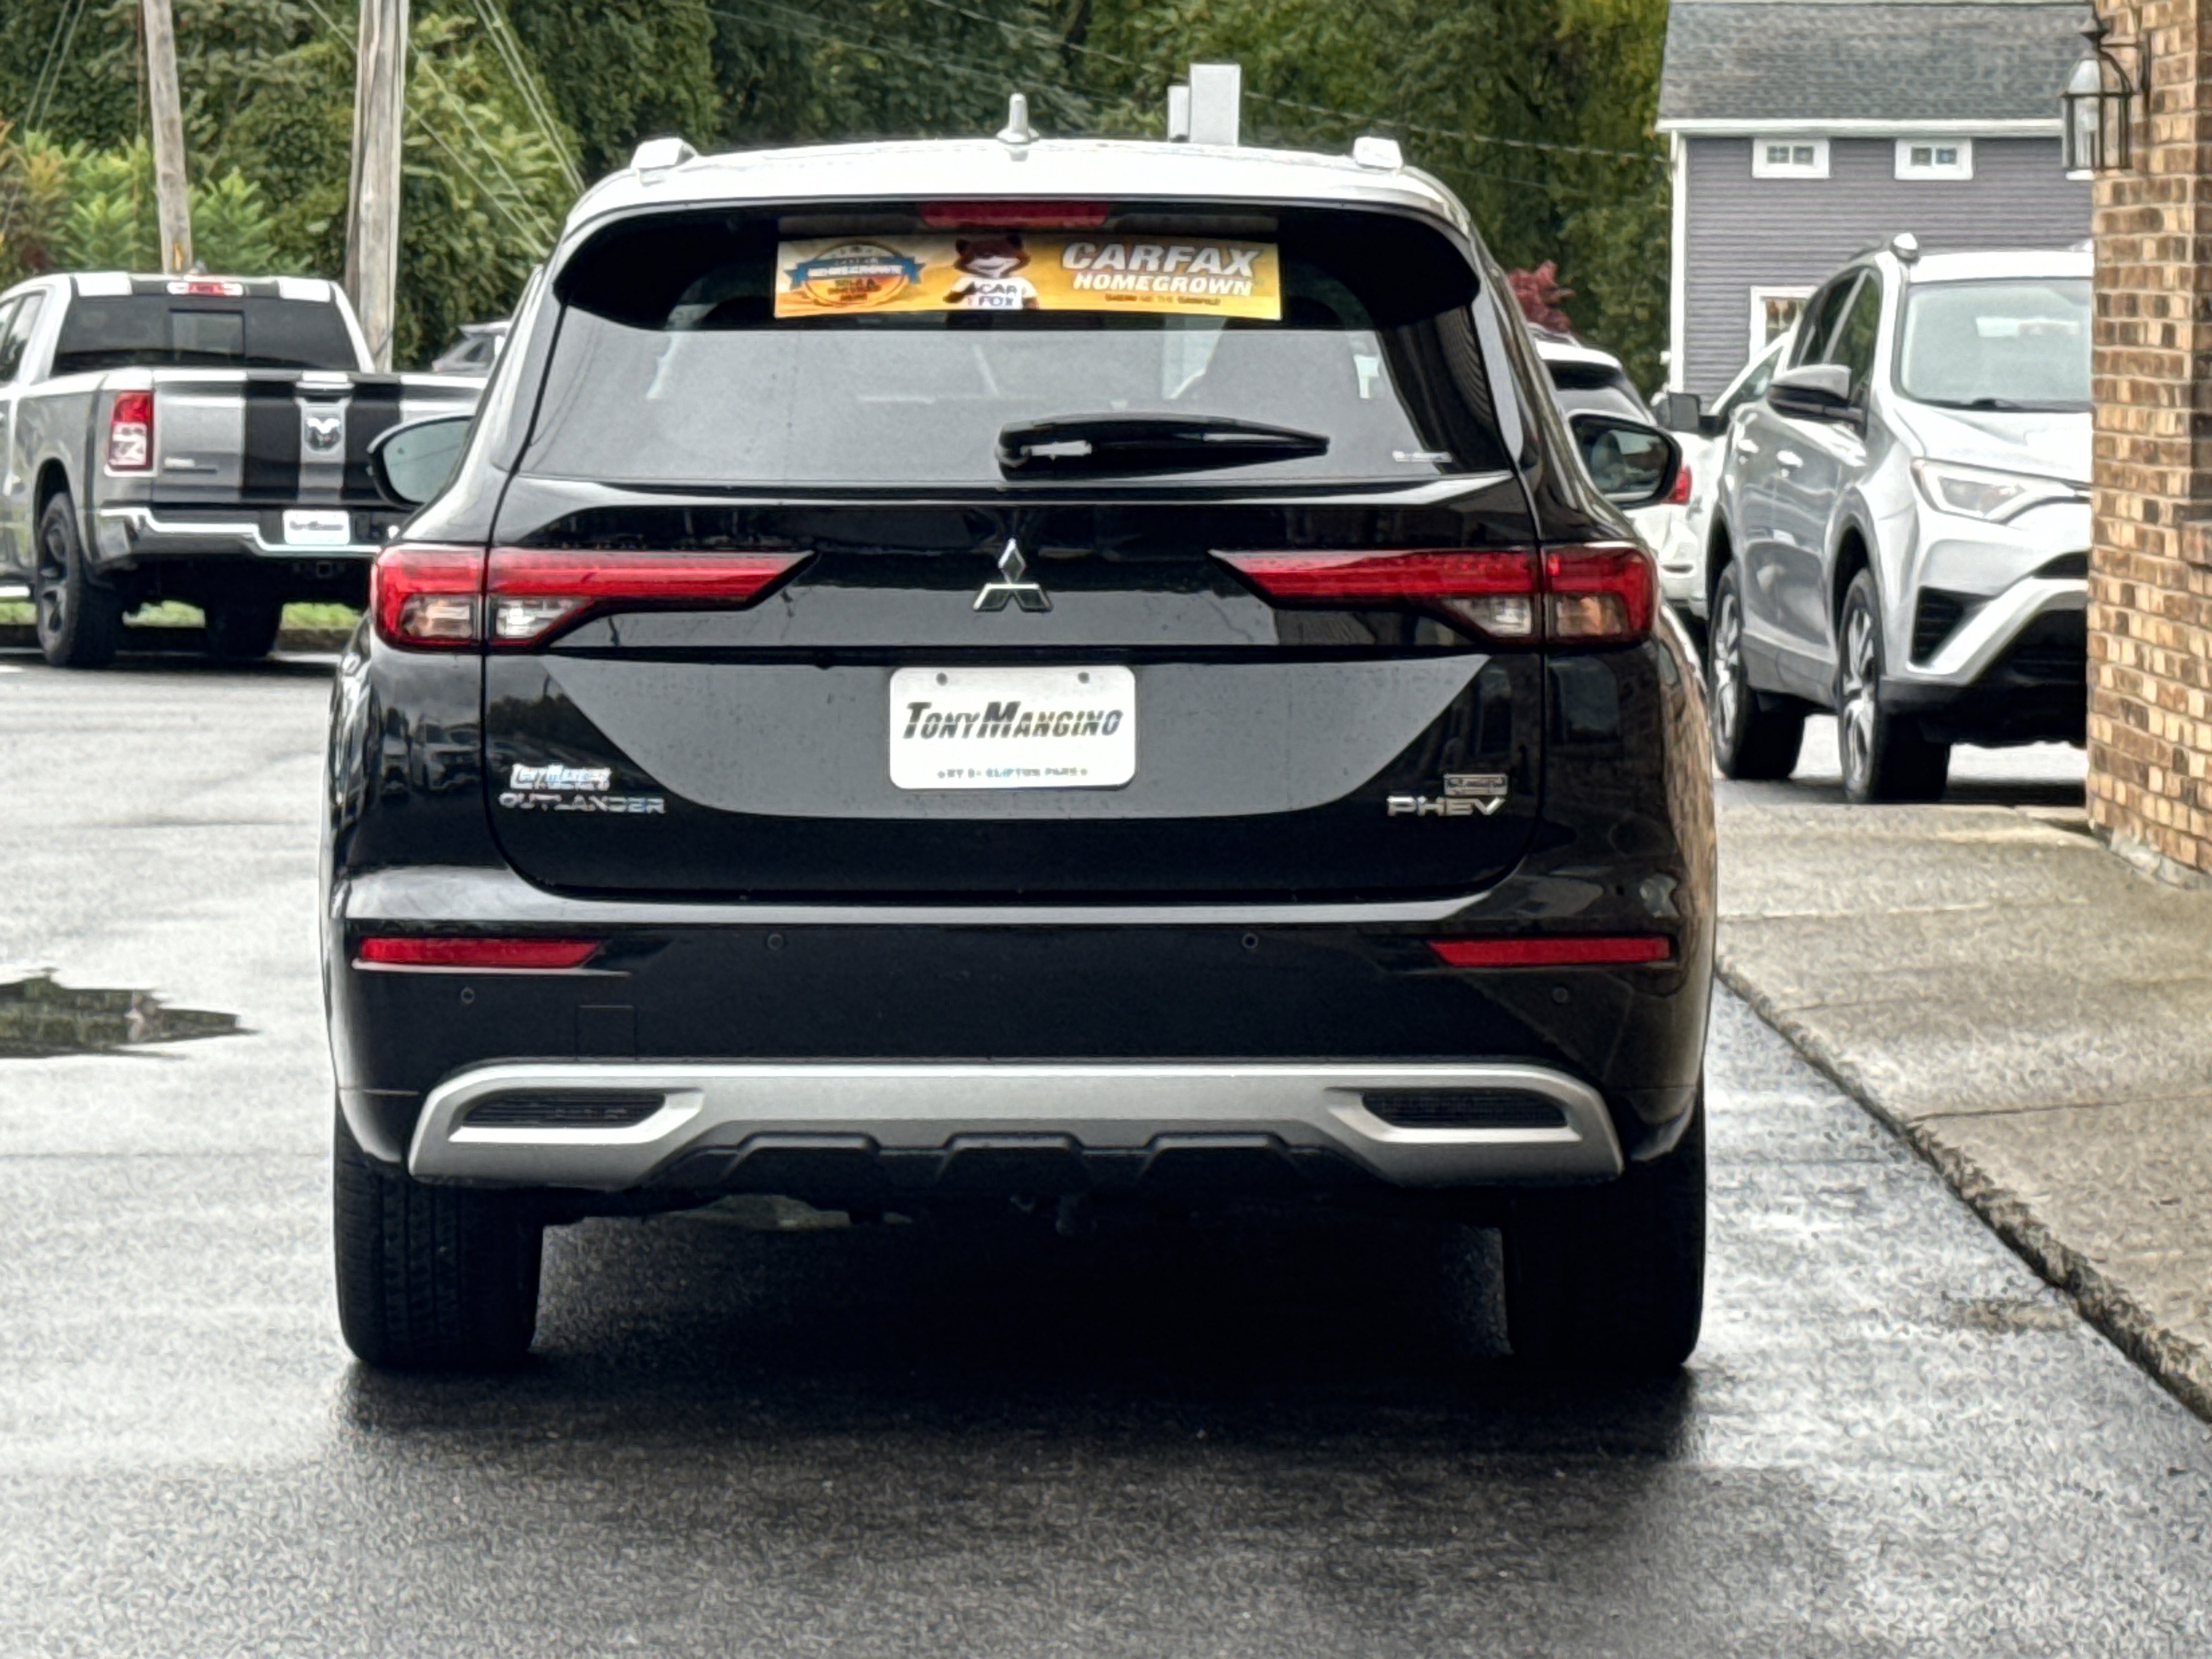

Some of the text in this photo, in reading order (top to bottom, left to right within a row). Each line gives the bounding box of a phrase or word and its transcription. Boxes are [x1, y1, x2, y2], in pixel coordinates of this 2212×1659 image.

[1061, 241, 1260, 278] CARFAX
[979, 283, 1018, 295] CAR
[1073, 272, 1254, 297] HOMEGROWN
[499, 792, 666, 814] OUTLANDER
[1386, 795, 1506, 817] PHEV
